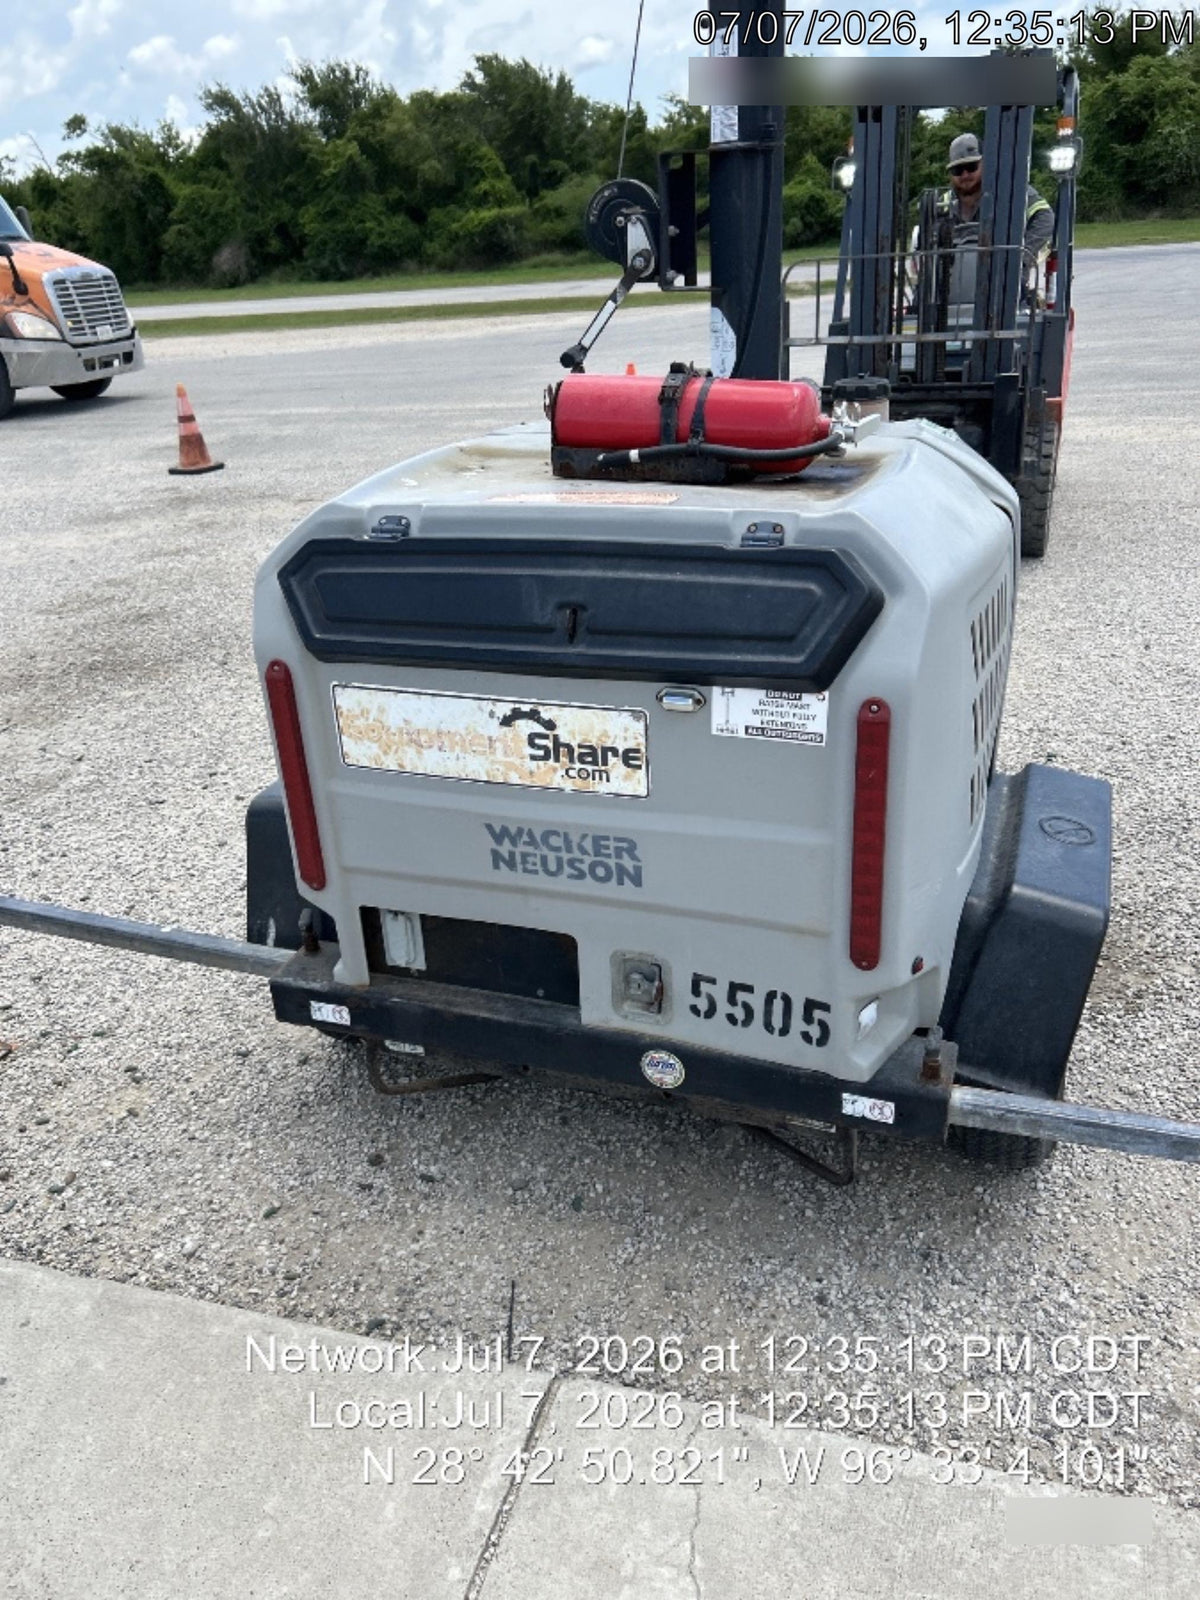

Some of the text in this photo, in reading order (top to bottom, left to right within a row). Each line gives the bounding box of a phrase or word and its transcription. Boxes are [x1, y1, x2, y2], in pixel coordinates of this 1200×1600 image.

[561, 767, 610, 783] .com
[484, 822, 642, 863] WACKER
[489, 848, 644, 889] NEUSON
[688, 971, 832, 1048] 5505
